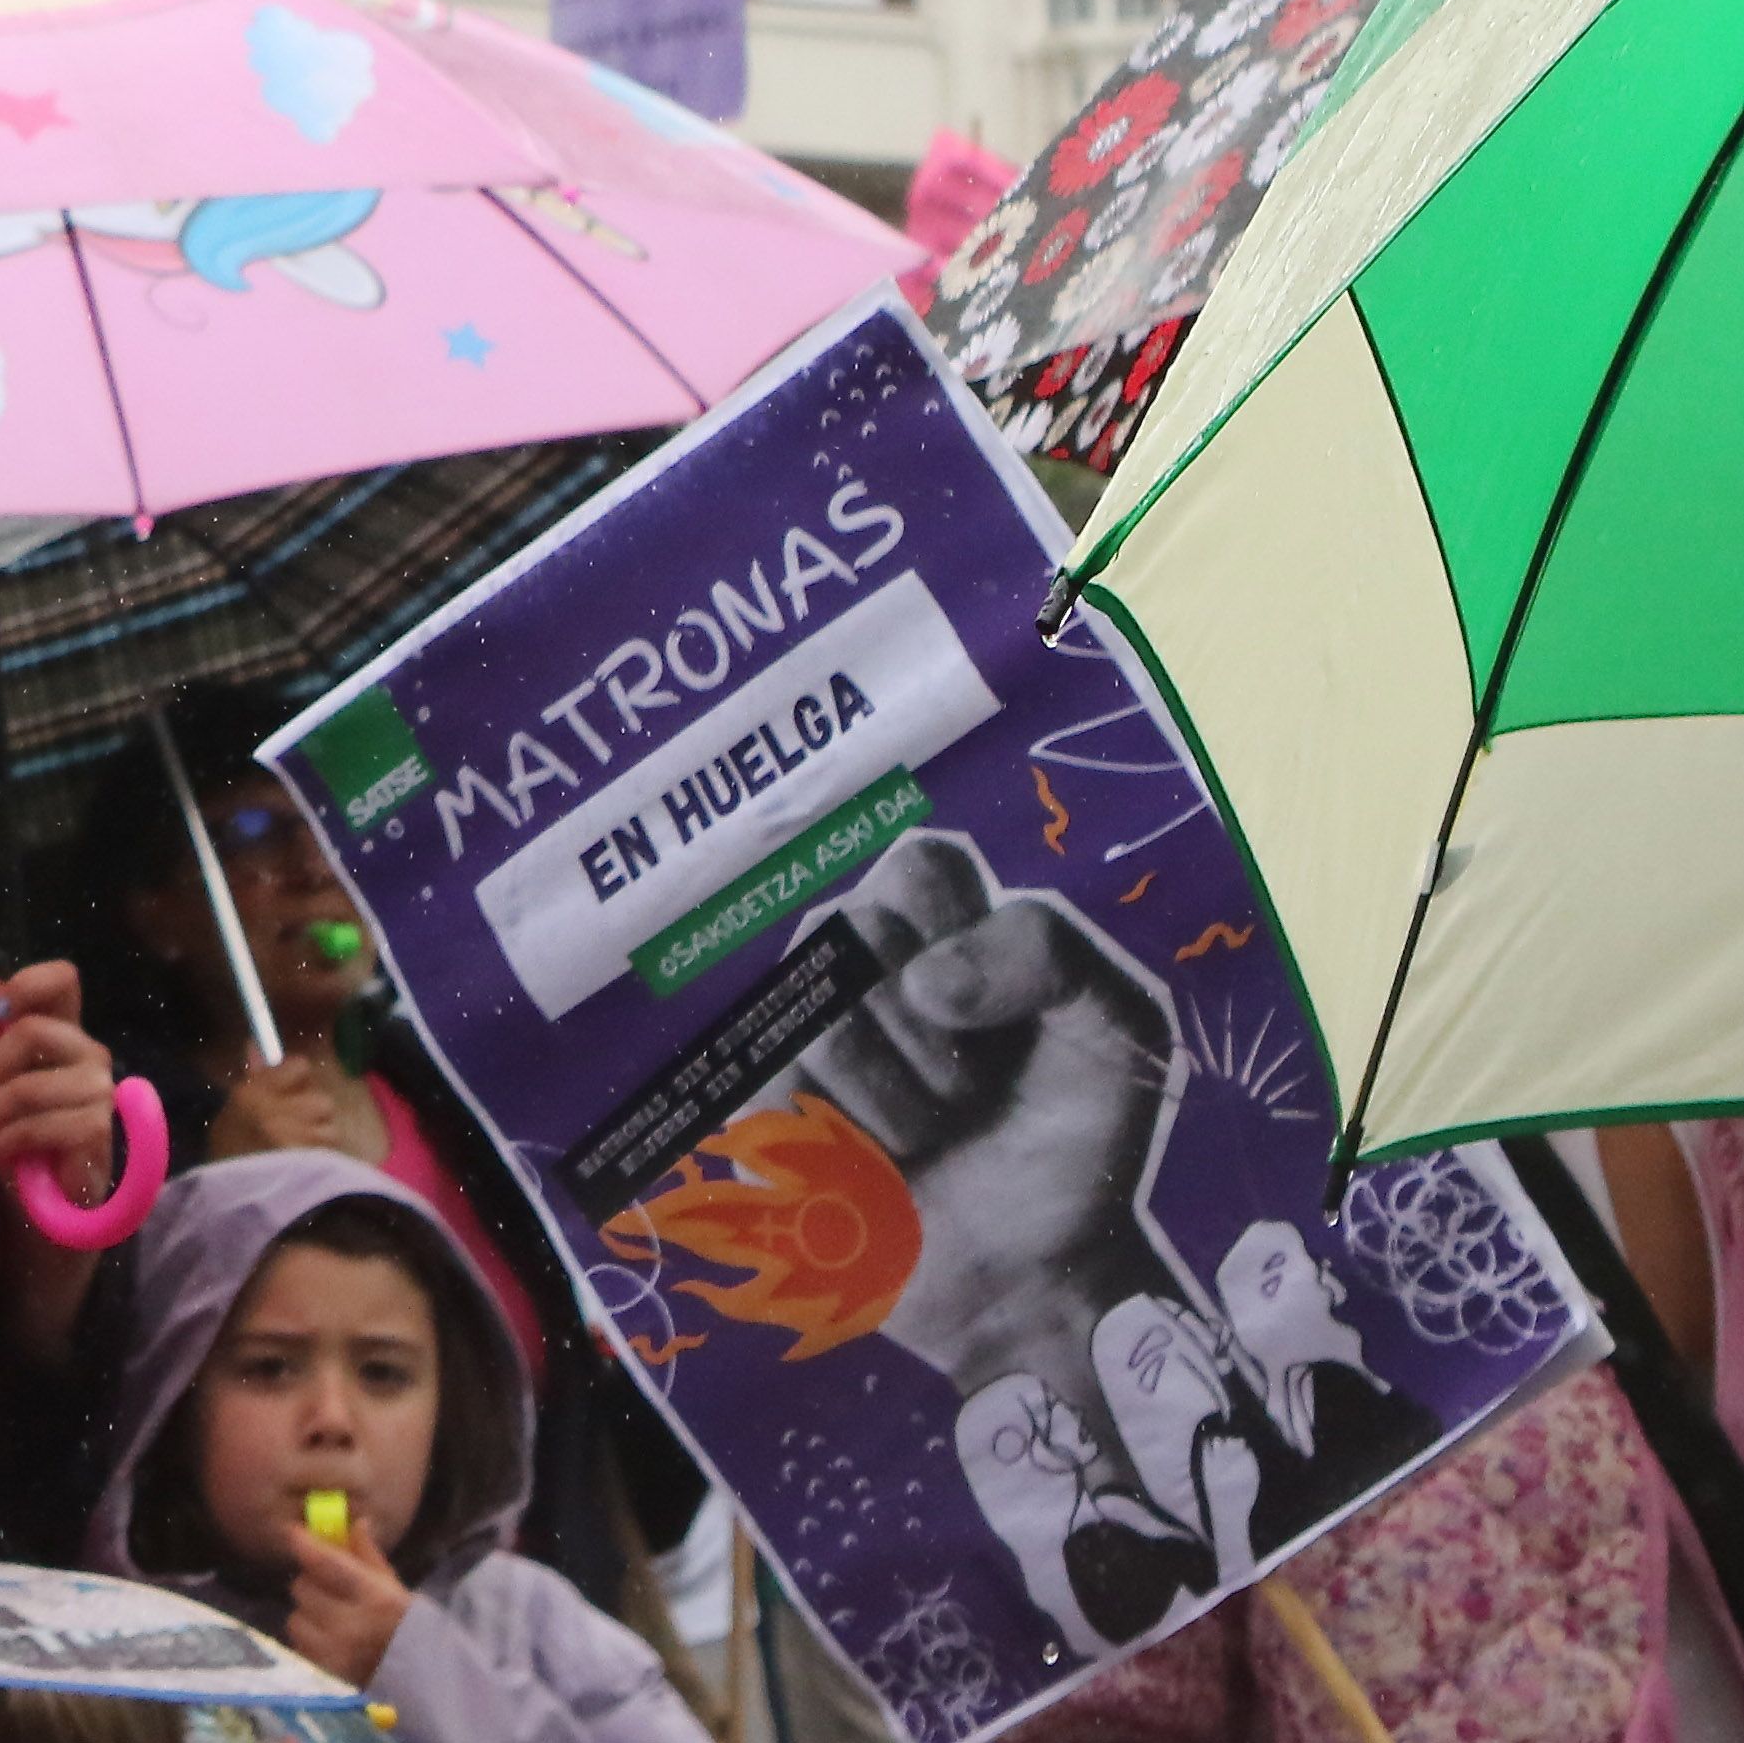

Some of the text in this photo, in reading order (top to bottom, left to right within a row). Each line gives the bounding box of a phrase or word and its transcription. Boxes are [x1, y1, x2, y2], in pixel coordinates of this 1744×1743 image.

[433, 482, 905, 860] MATRONAS
[345, 755, 429, 827] SATSE
[578, 670, 875, 904] EN HUELGA
[813, 812, 873, 876] ASKI
